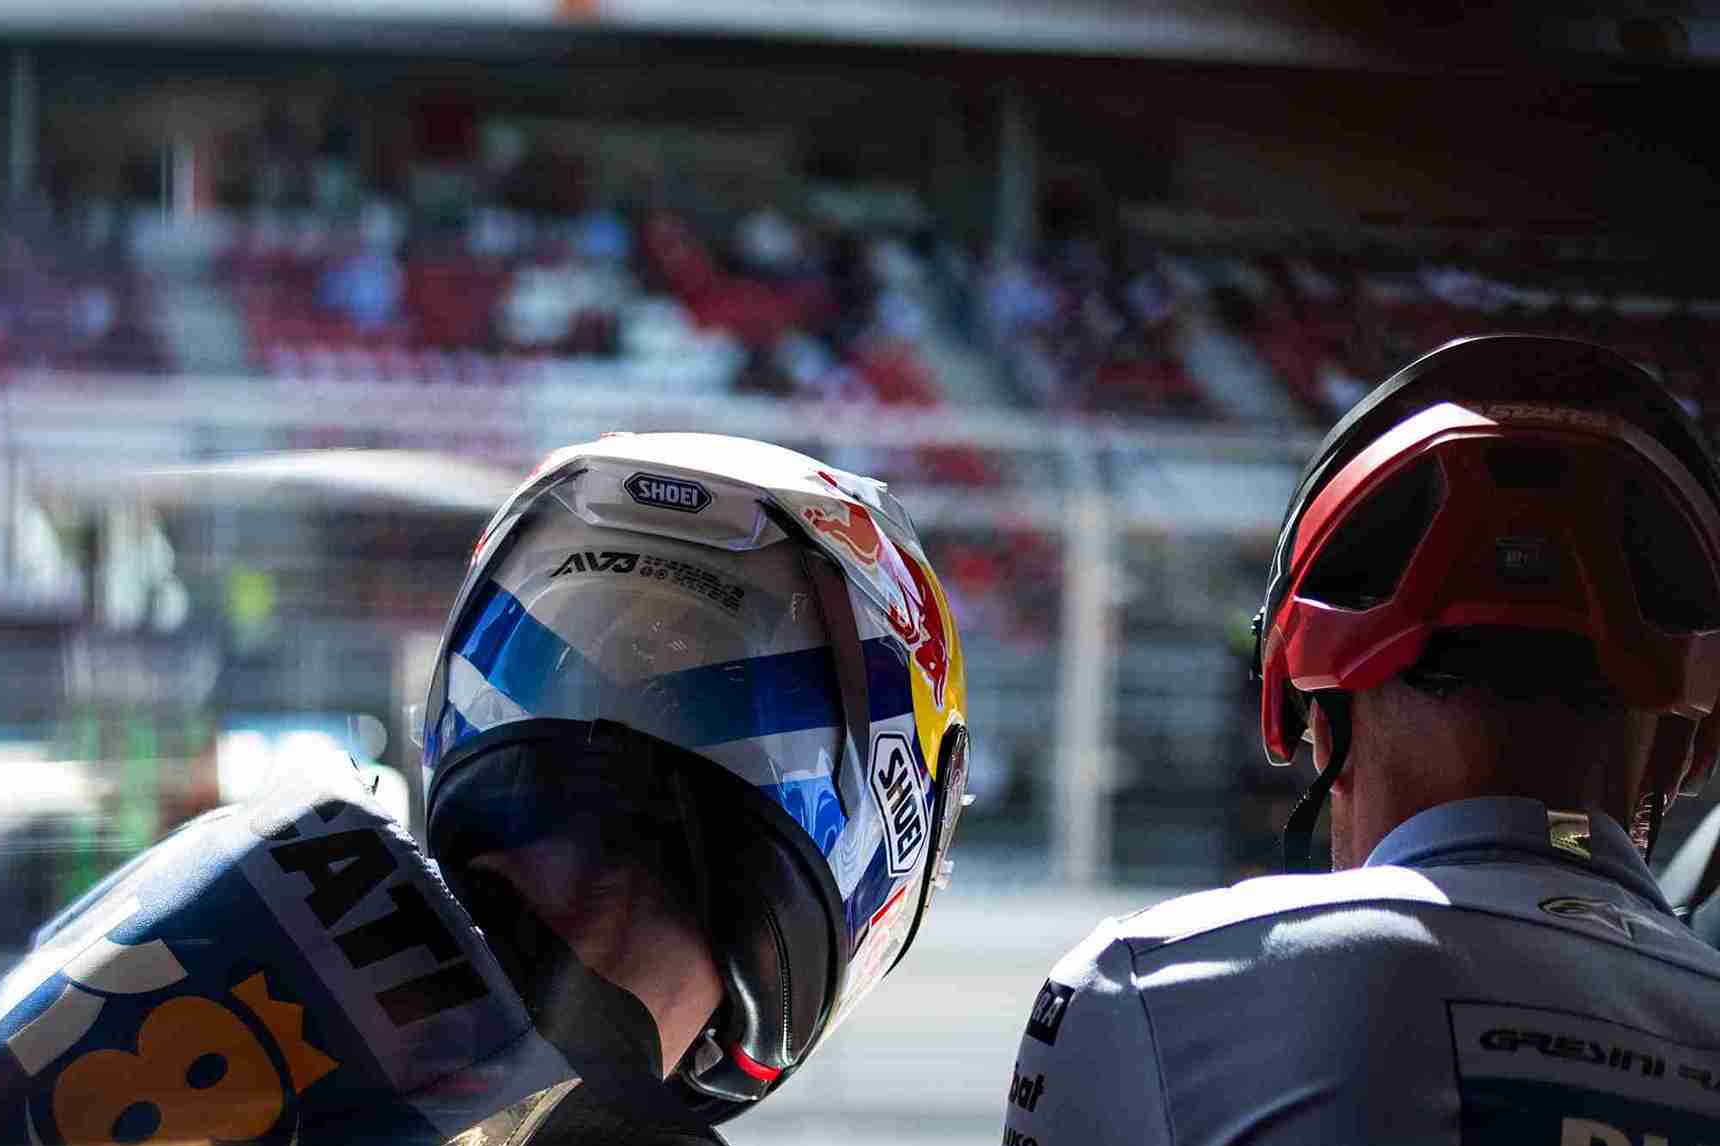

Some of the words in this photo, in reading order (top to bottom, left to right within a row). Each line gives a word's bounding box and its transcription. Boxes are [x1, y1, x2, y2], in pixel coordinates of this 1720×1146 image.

[636, 478, 700, 509] SHOEI
[877, 746, 923, 865] SHOEI
[1479, 1029, 1665, 1077] GRESINI
